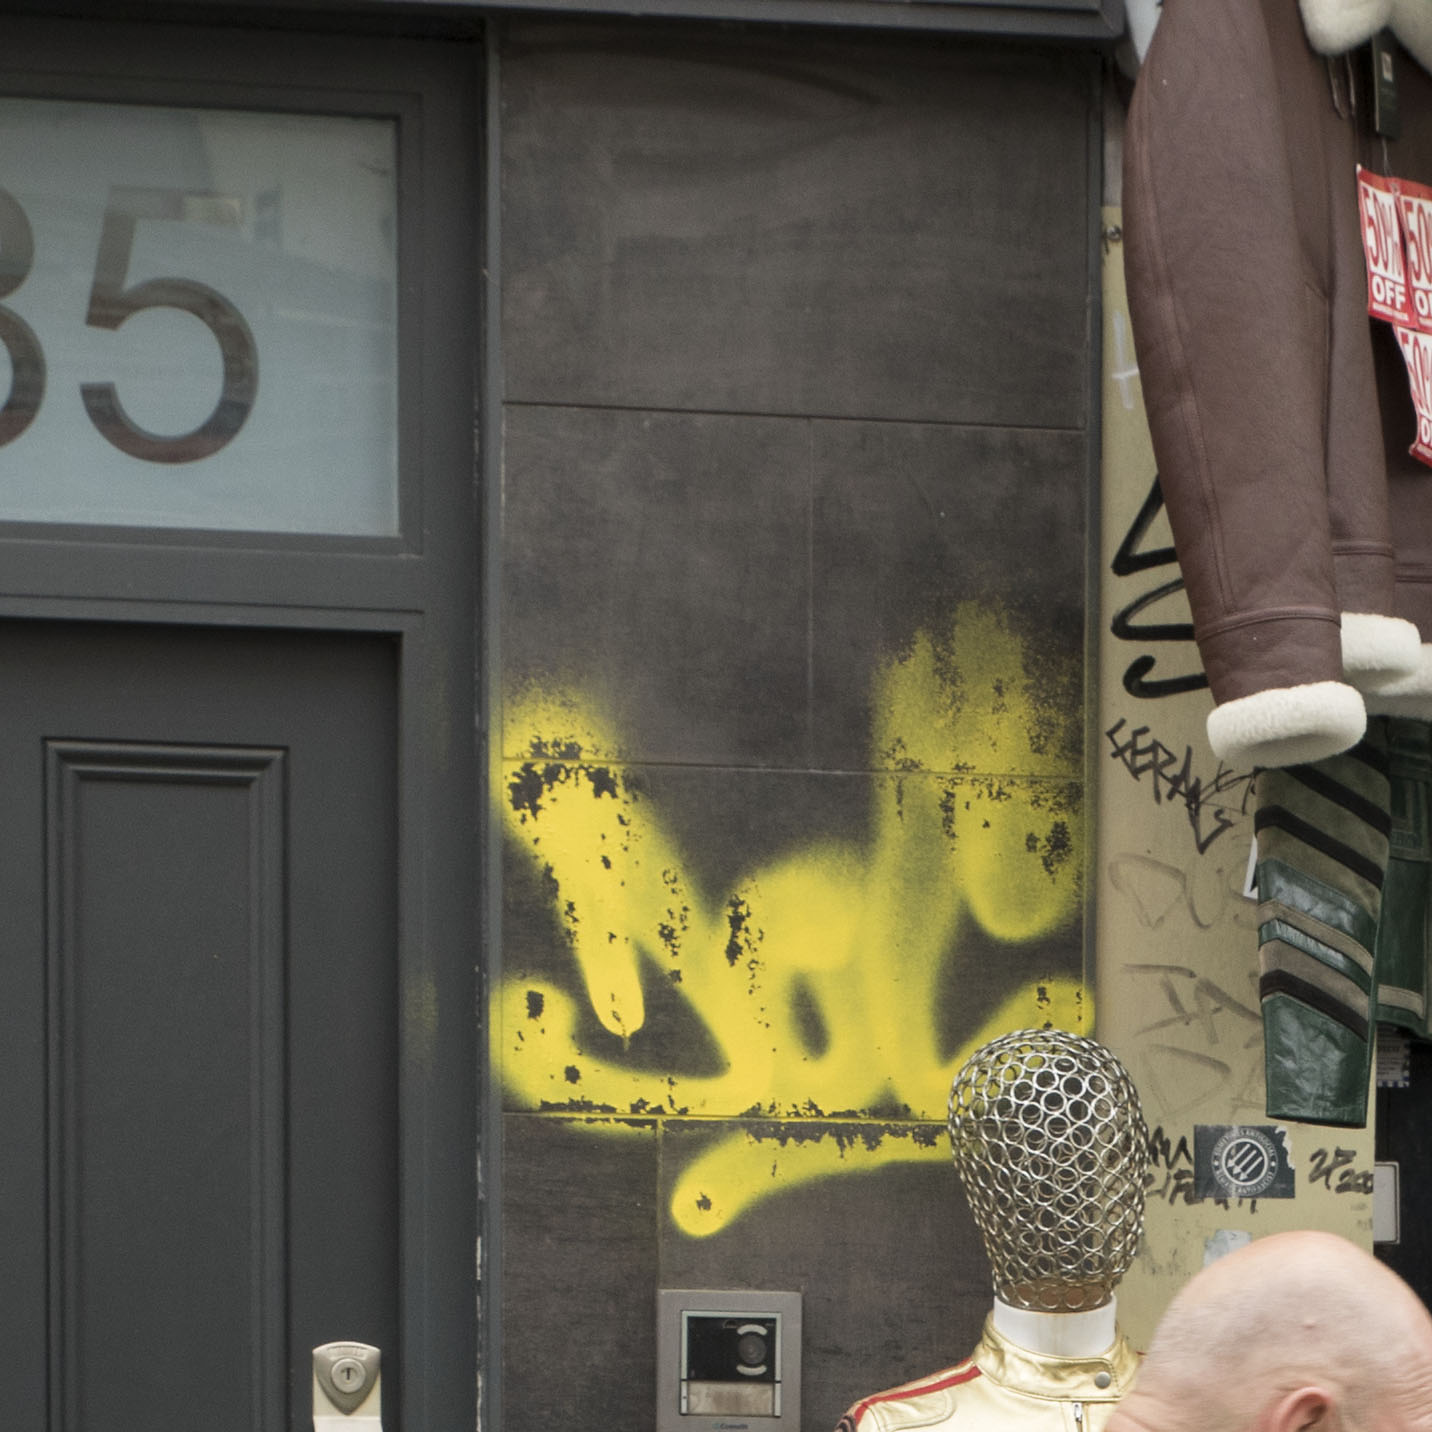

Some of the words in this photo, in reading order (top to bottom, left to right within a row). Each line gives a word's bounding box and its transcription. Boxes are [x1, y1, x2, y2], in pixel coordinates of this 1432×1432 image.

[1363, 185, 1403, 278] 50%
[0, 185, 259, 465] 5
[1372, 277, 1406, 310] OFF
